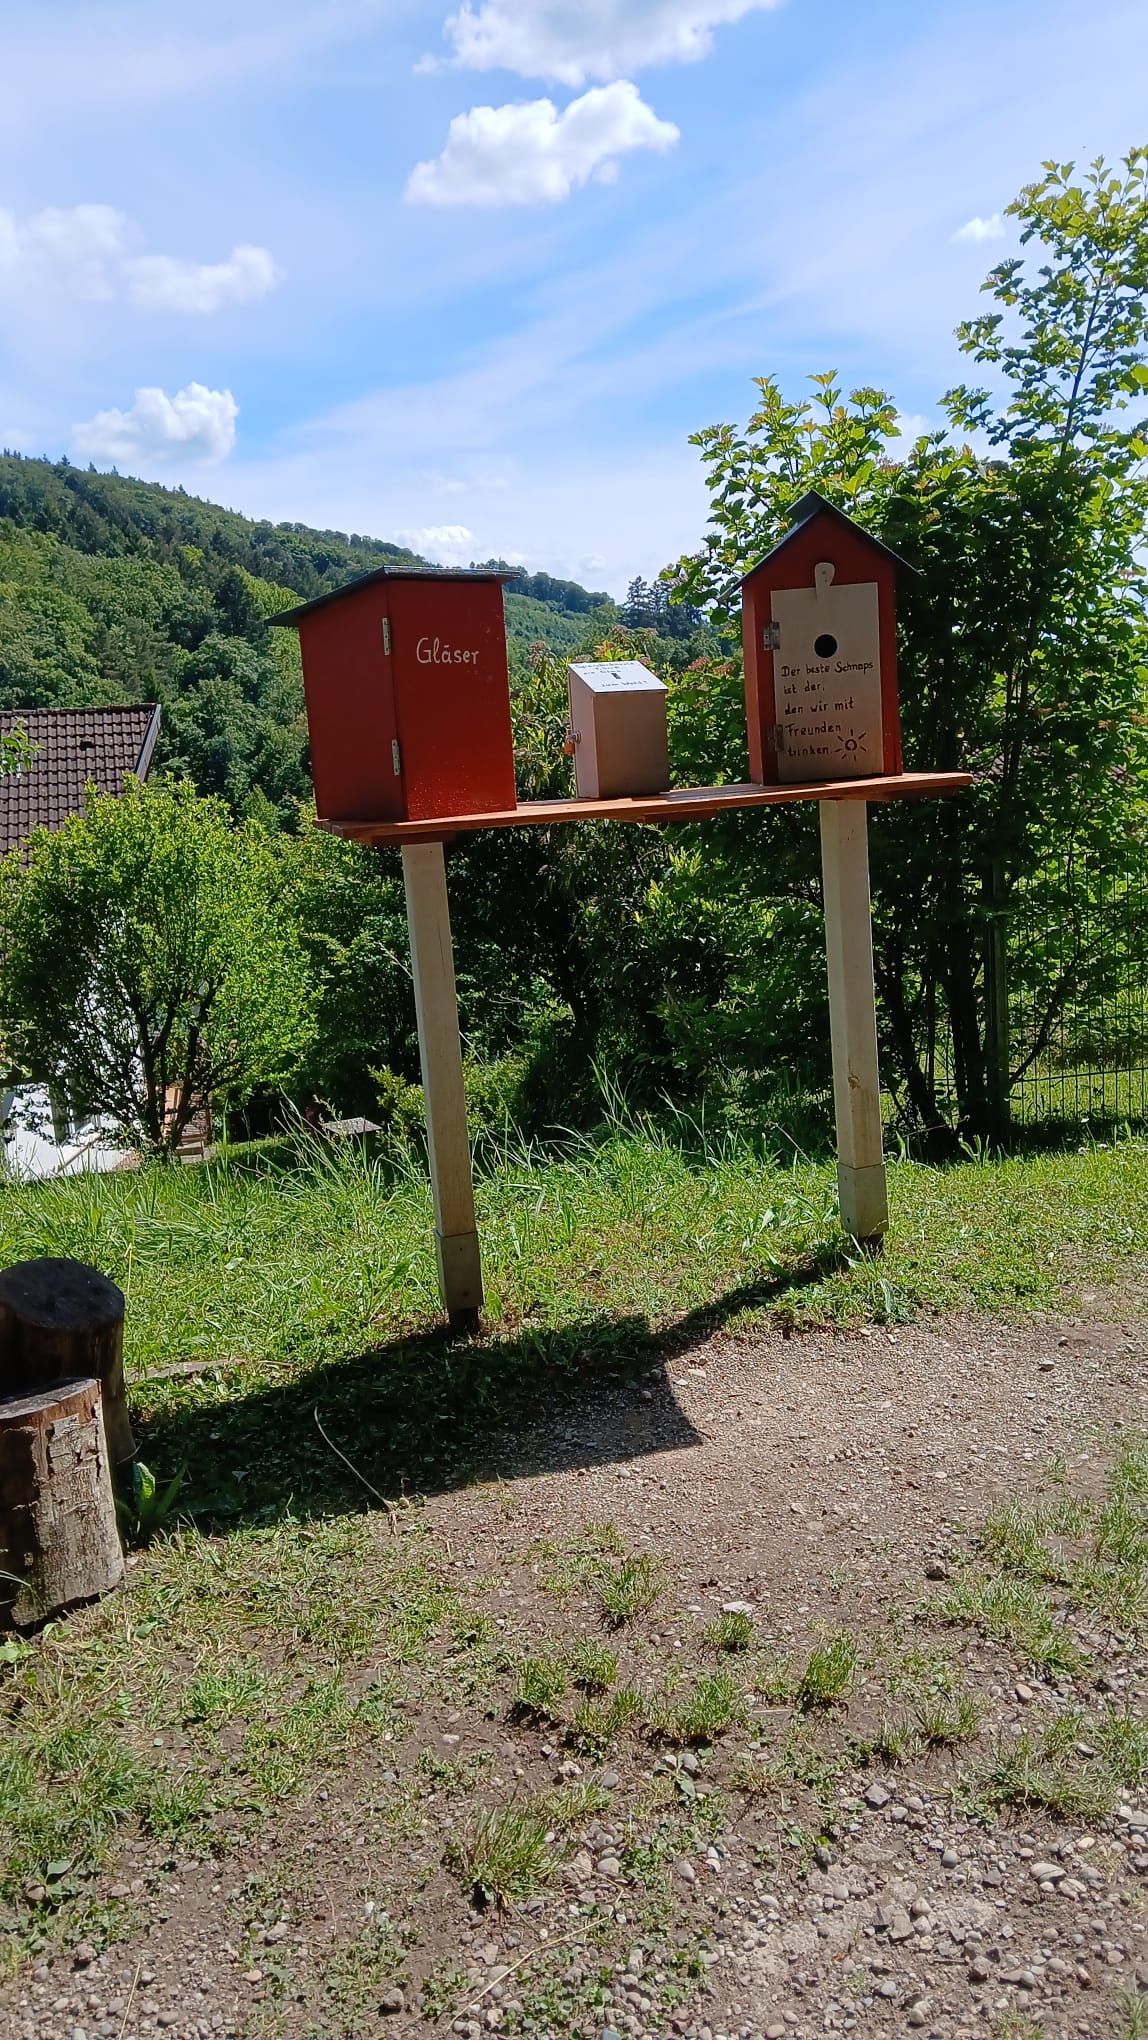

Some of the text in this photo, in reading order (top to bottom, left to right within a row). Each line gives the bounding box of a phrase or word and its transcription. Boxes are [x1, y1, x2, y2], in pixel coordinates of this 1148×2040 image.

[781, 661, 874, 677] Der beste Schnaps
[783, 684, 797, 694] ist
[785, 697, 854, 715] den wir mit
[785, 721, 841, 736] Freunden
